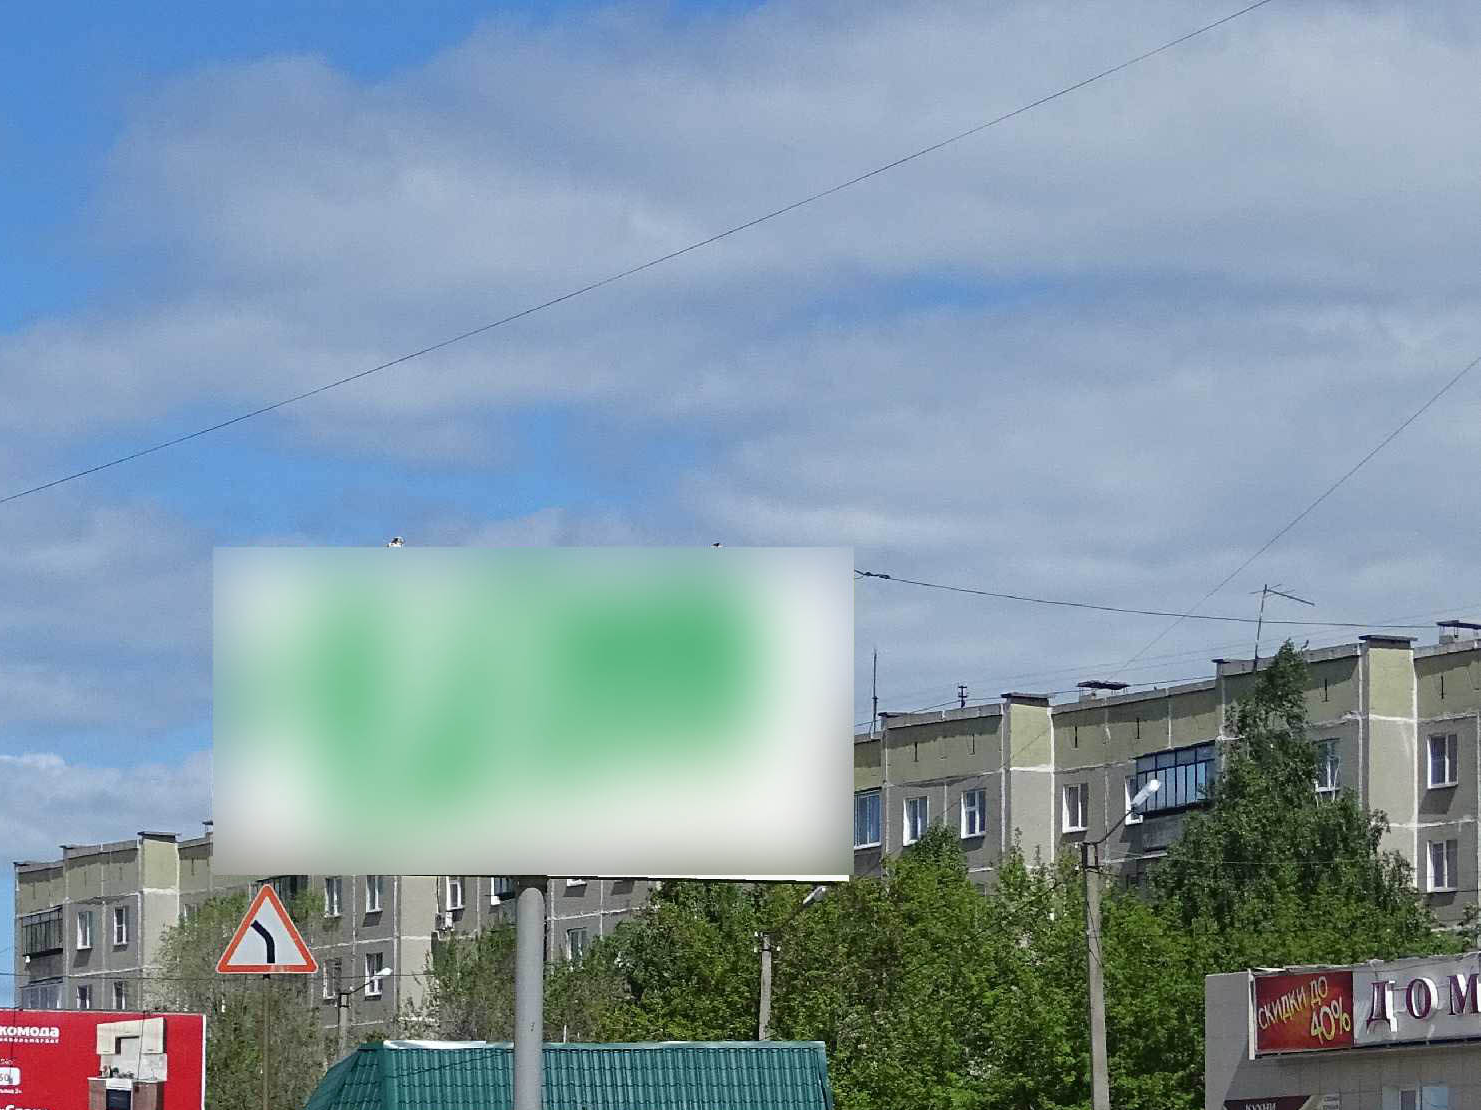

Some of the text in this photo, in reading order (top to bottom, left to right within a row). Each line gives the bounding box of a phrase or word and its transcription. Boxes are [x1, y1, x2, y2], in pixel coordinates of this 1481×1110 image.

[1258, 976, 1328, 1030] СКИДКИ ДО
[1310, 997, 1351, 1044] 40%
